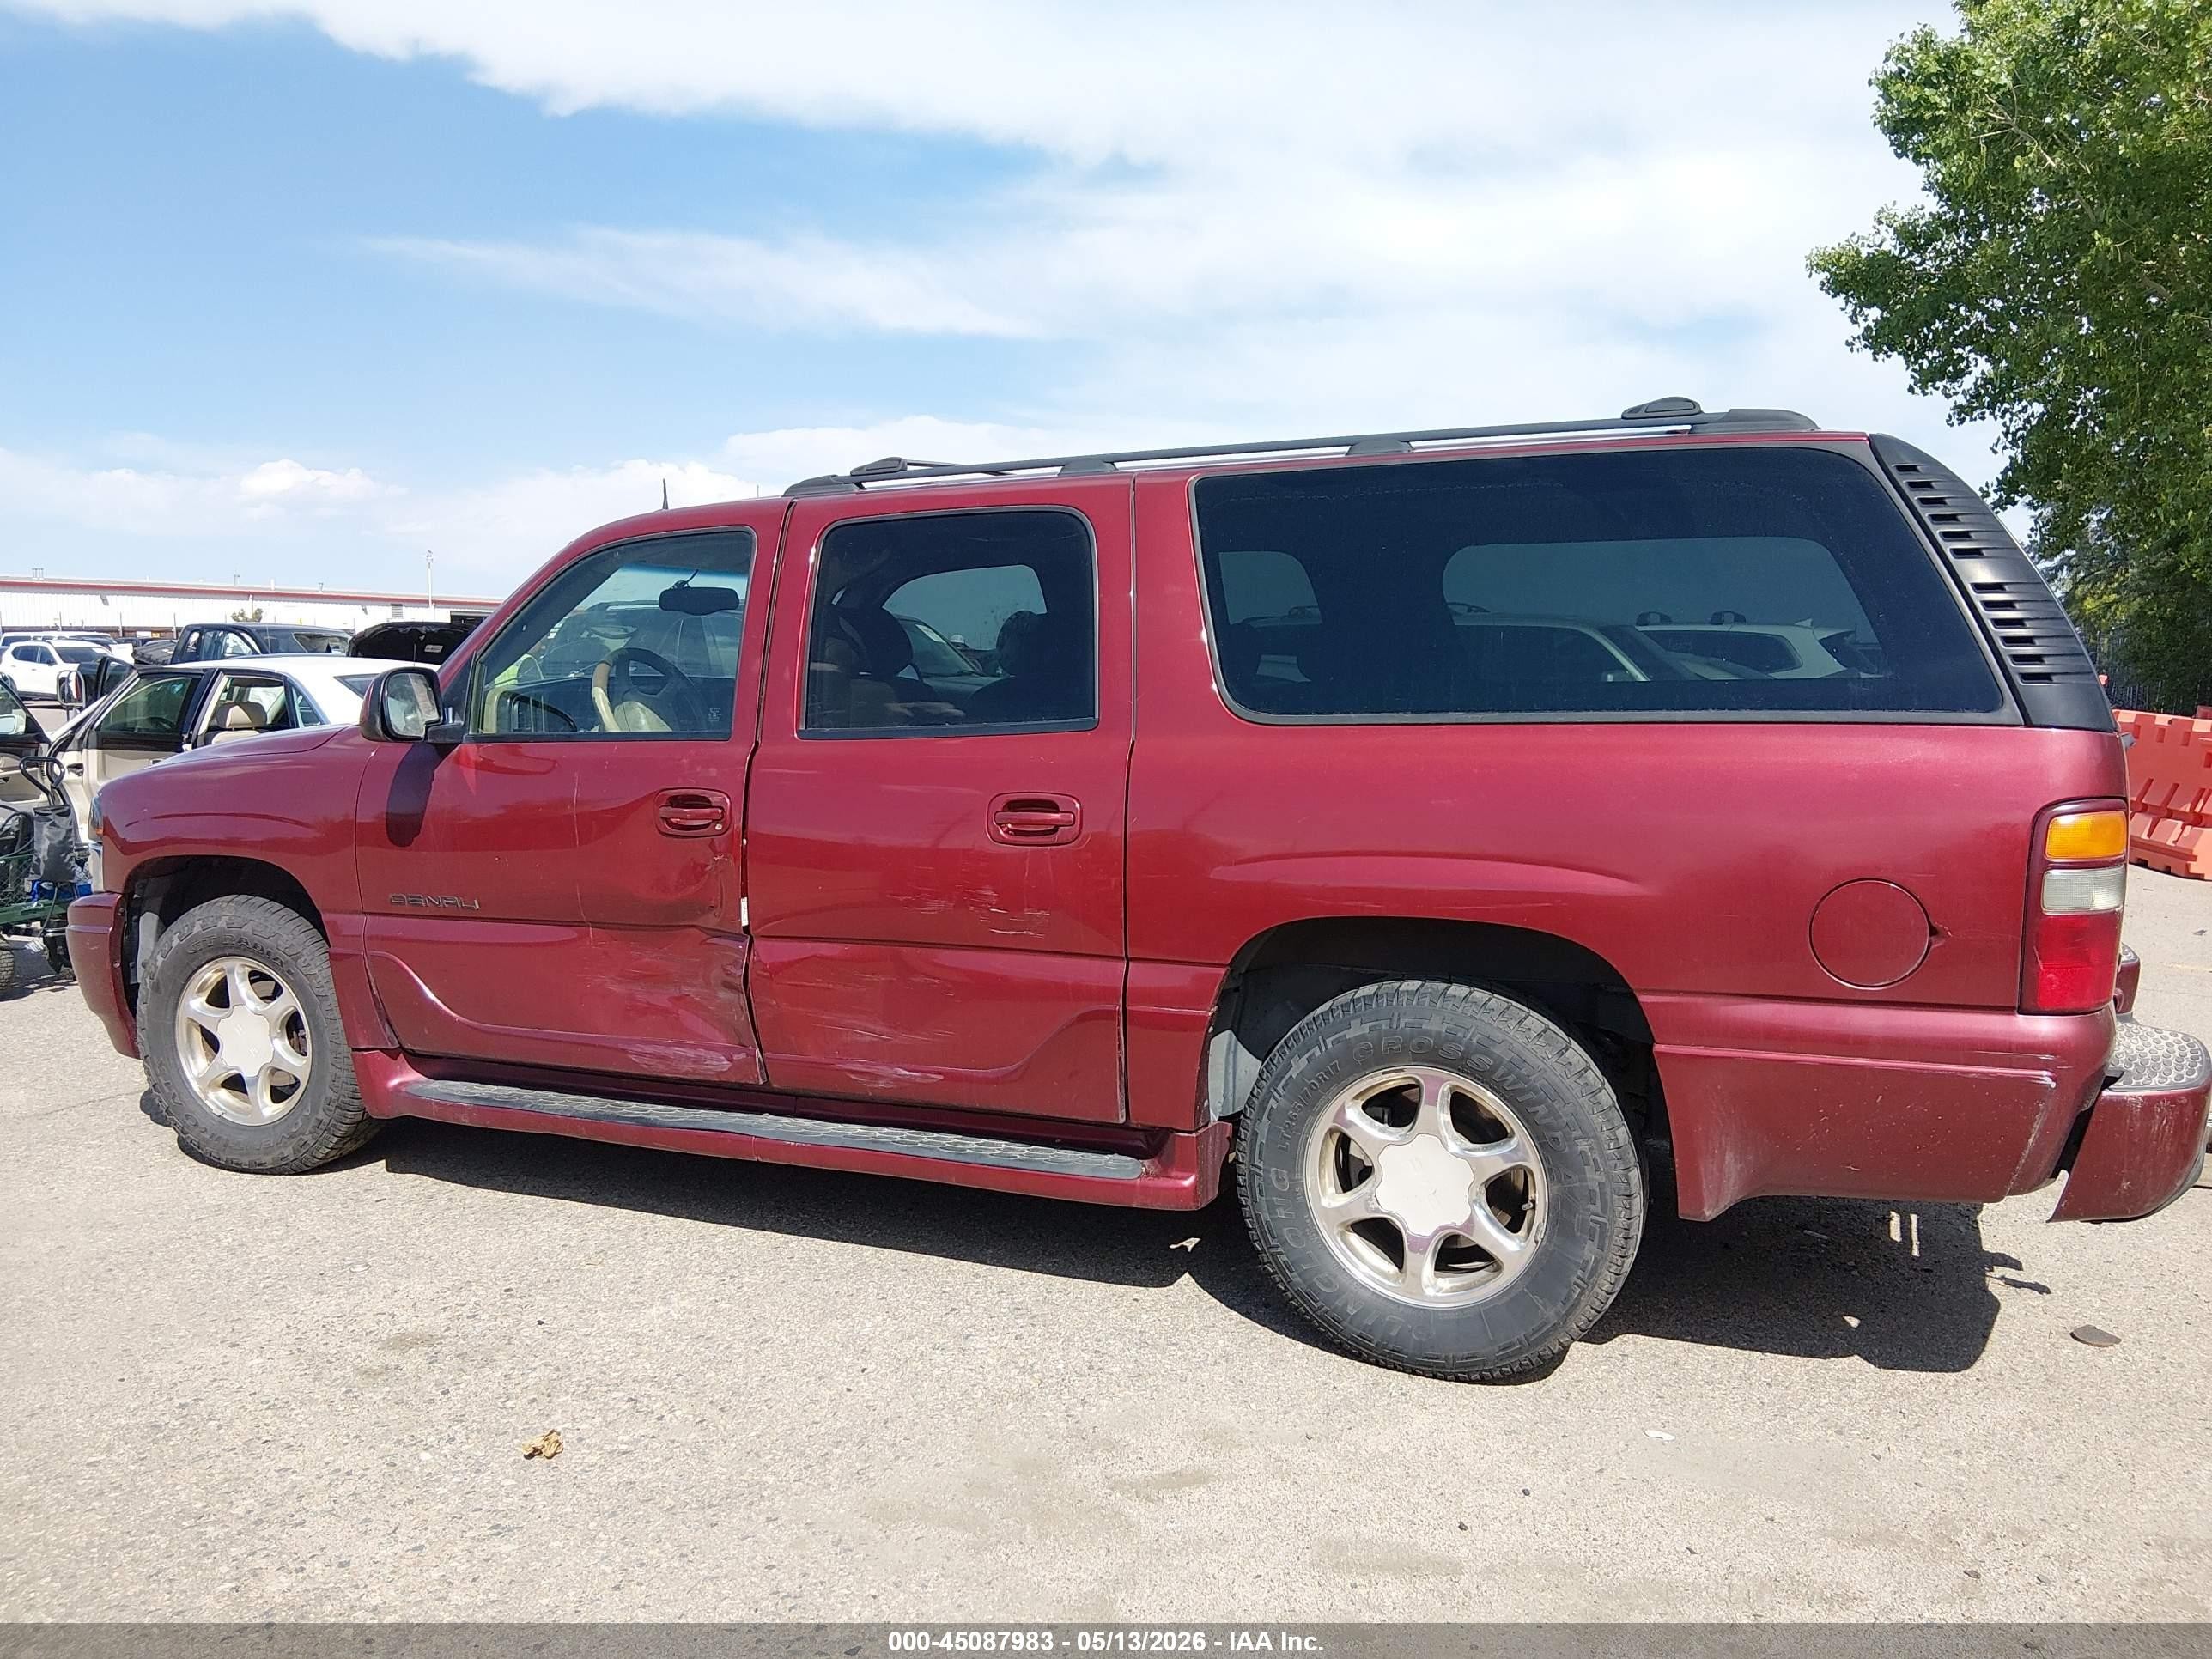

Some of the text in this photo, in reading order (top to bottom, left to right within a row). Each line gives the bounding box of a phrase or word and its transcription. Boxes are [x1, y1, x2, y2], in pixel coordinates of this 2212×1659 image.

[390, 893, 480, 911] DENALI
[1277, 1060, 1341, 1153] LT265/70R17
[1352, 1036, 1569, 1154] CROSSWIND
[1270, 1167, 1406, 1337] LINGLONG
